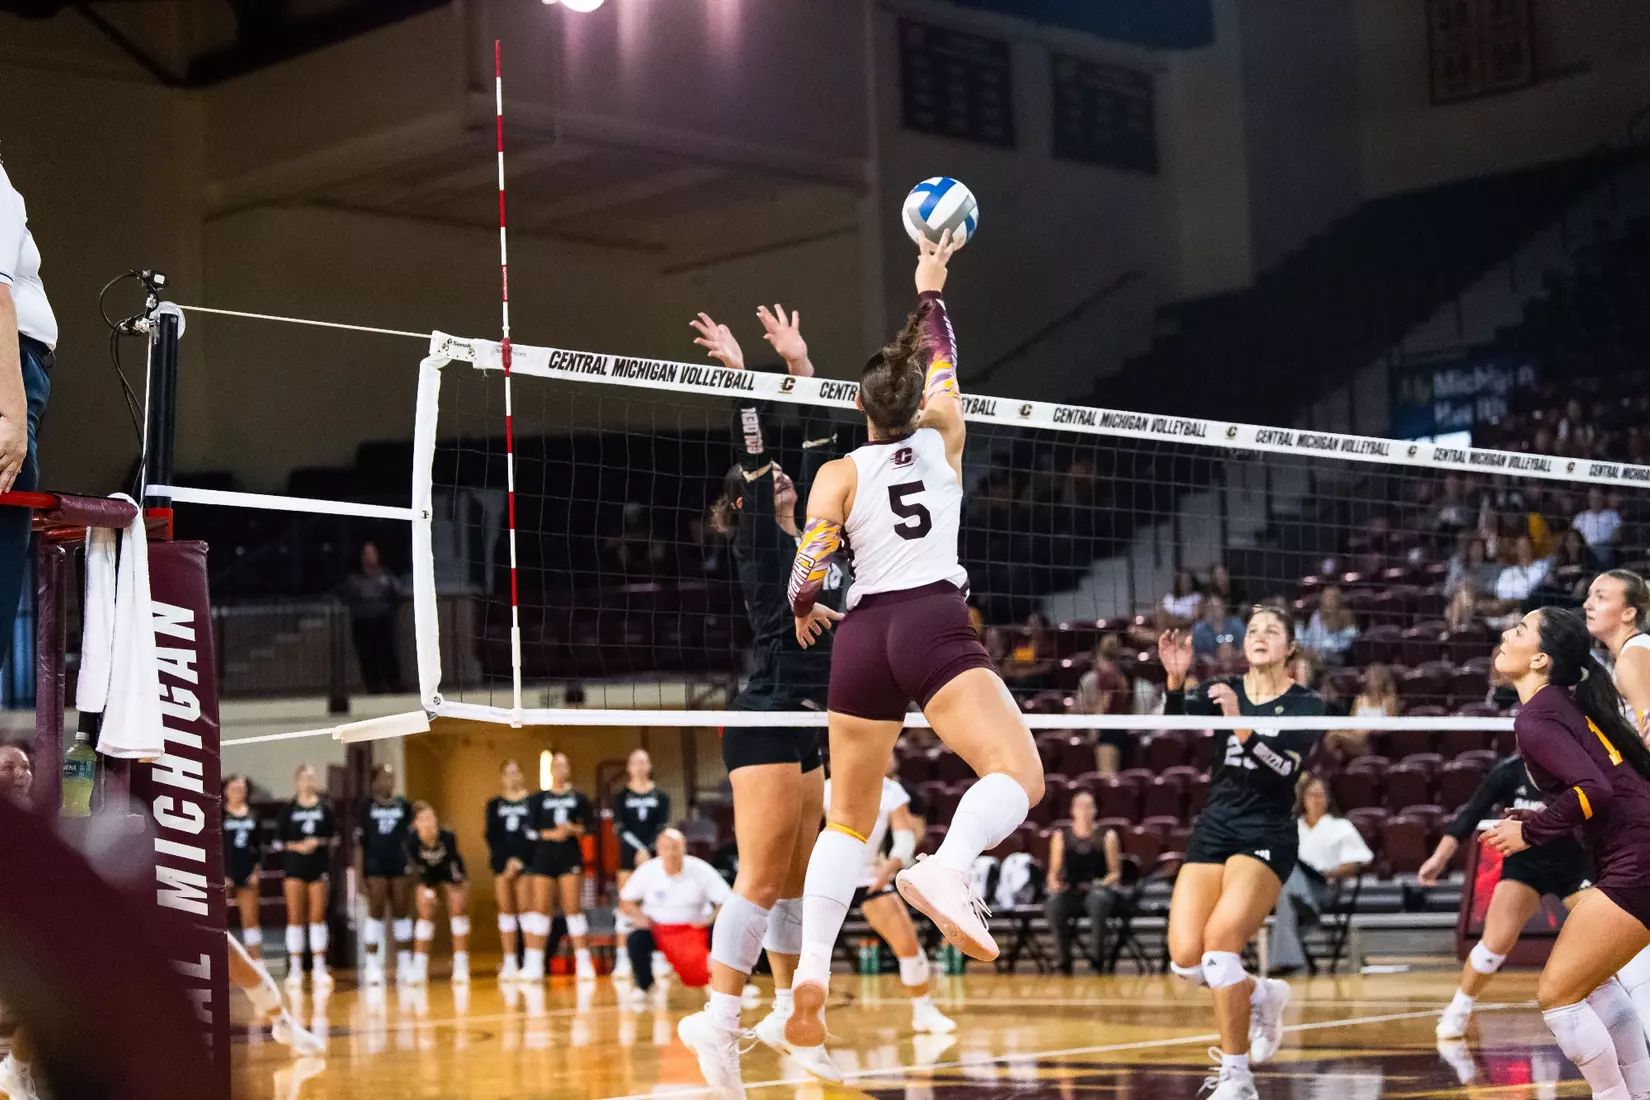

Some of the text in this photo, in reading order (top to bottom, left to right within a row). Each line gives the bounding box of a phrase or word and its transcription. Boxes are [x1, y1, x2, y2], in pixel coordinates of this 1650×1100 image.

[548, 351, 755, 391] CENTRAL MICHIGAN VOLLEYBALL
[819, 381, 858, 401] CENTR
[1053, 407, 1207, 437] CENTRAL MICHIGAN VOLLEYBALL
[1255, 429, 1390, 456] CENTRAL MICHIGAN VOLLEYBALL
[1433, 447, 1551, 472] CENTRAL MICHIGAN VOLLEYBALL
[1589, 464, 1650, 481] CENTRAL MICHIGA
[888, 480, 932, 541] 5
[151, 600, 209, 916] MICHIGAN
[1224, 735, 1259, 770] 2
